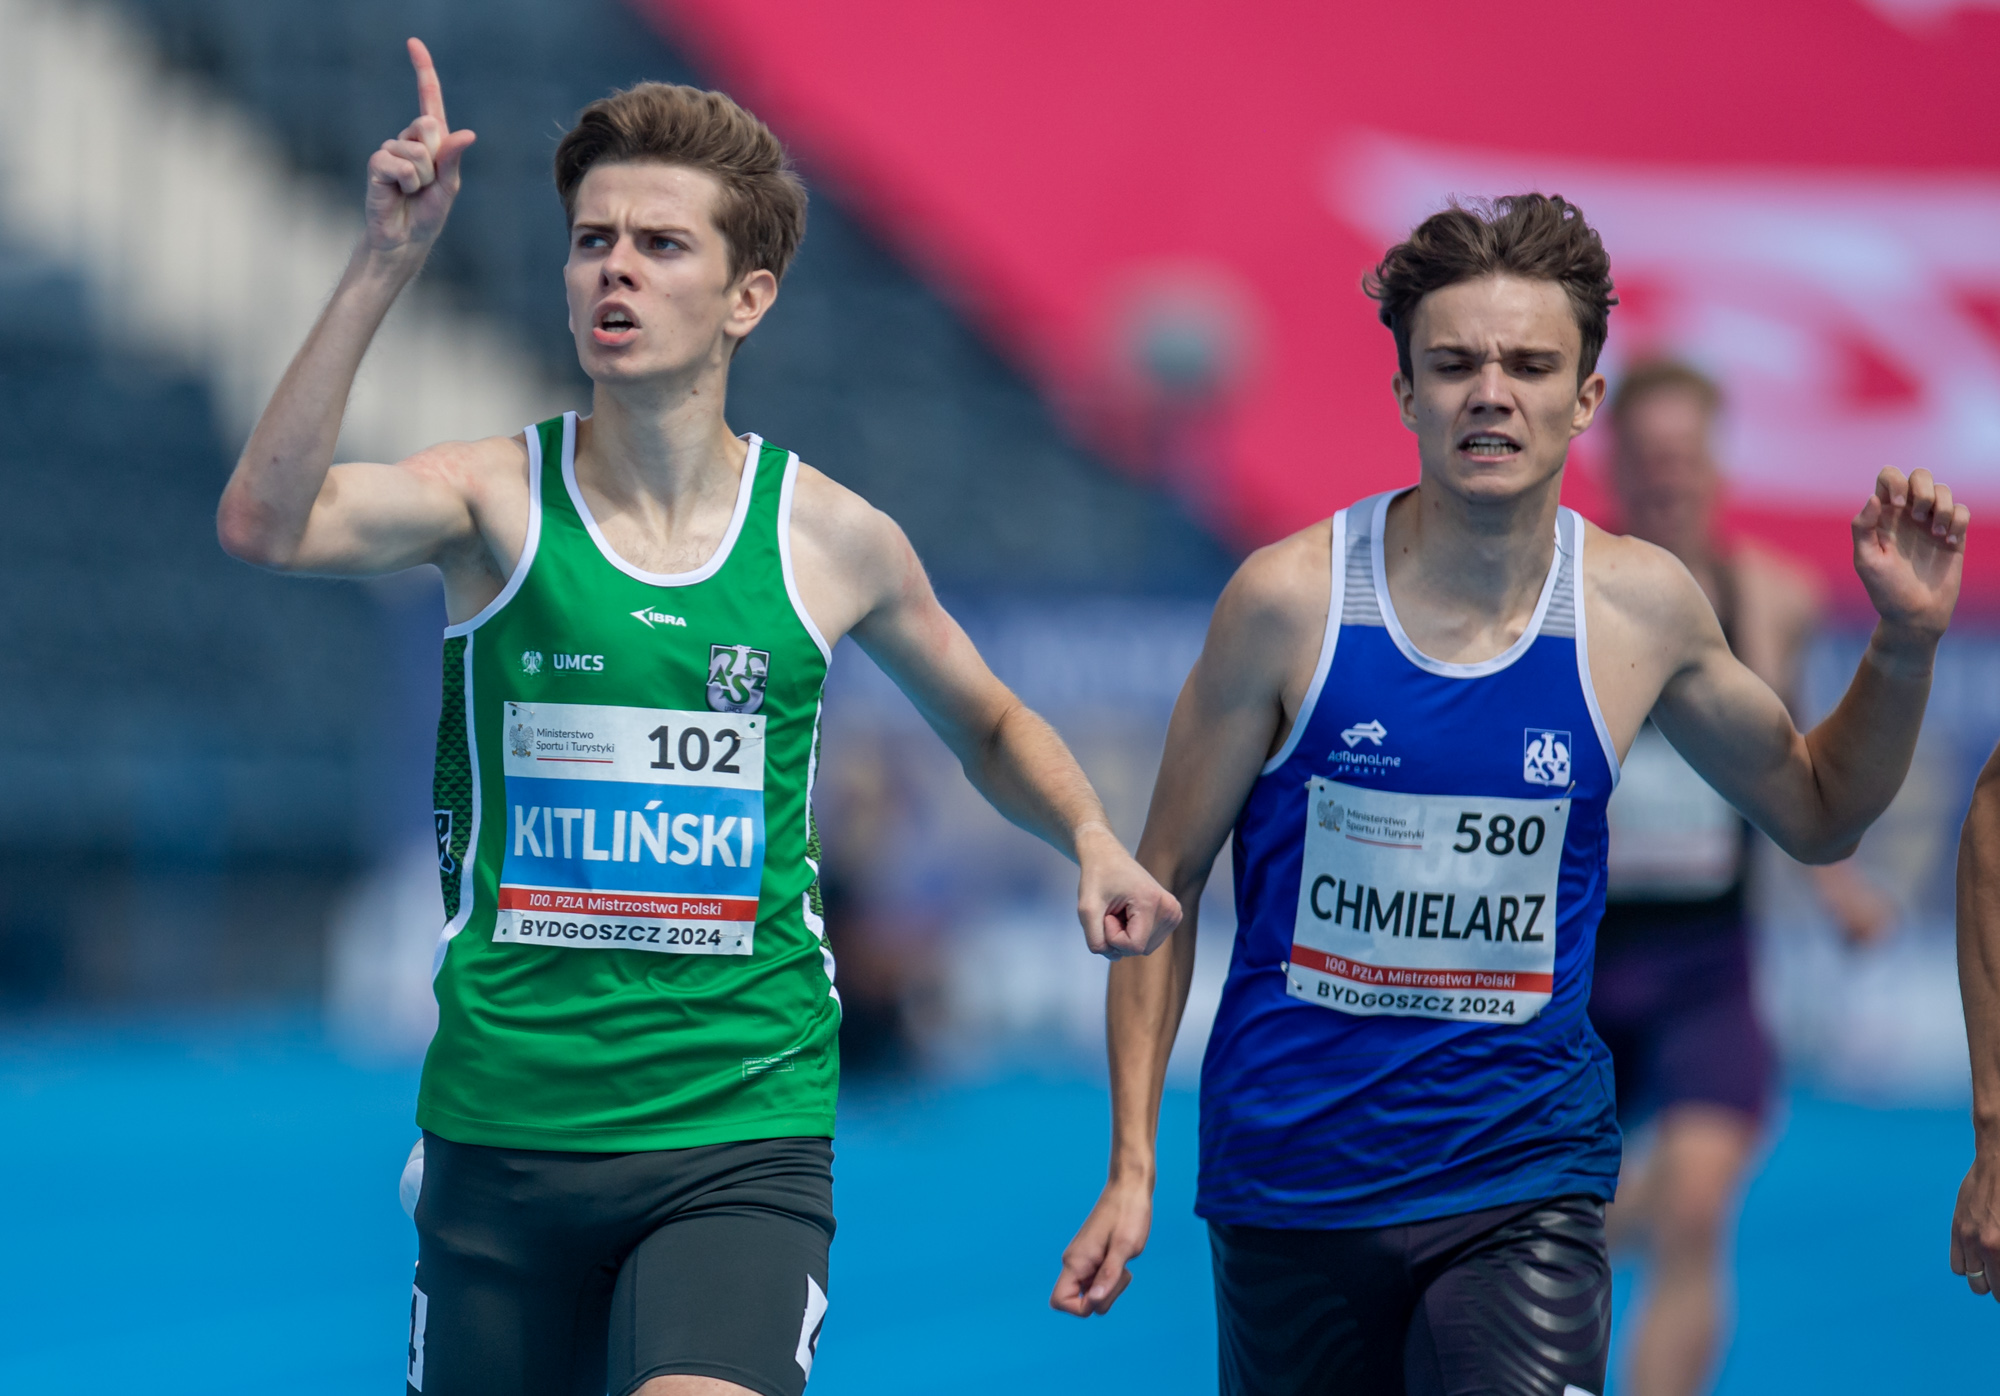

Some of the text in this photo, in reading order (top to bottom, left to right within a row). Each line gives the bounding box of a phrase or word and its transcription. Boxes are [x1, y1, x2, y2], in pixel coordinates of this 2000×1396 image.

[553, 653, 604, 671] UMCS
[536, 727, 594, 740] Ministerstwo
[536, 740, 564, 752] Sportu
[571, 741, 615, 754] Turystyki
[648, 725, 741, 774] 102
[1345, 818, 1375, 836] Sportu
[1383, 827, 1425, 841] Turystyki
[1346, 807, 1407, 827] Ministerstwo
[513, 800, 754, 868] KITLIŃSKI
[1453, 811, 1546, 856] 580
[529, 893, 722, 916] 100. PZLA Mistrzostwa Polski
[1310, 873, 1546, 942] CHMIELARZ
[519, 919, 722, 946] BYDGOSZCZ 2024
[1325, 955, 1516, 988] 100. PZLA Mistrzostwa Polski
[1317, 981, 1516, 1016] BYDGOSZCZ 2024
